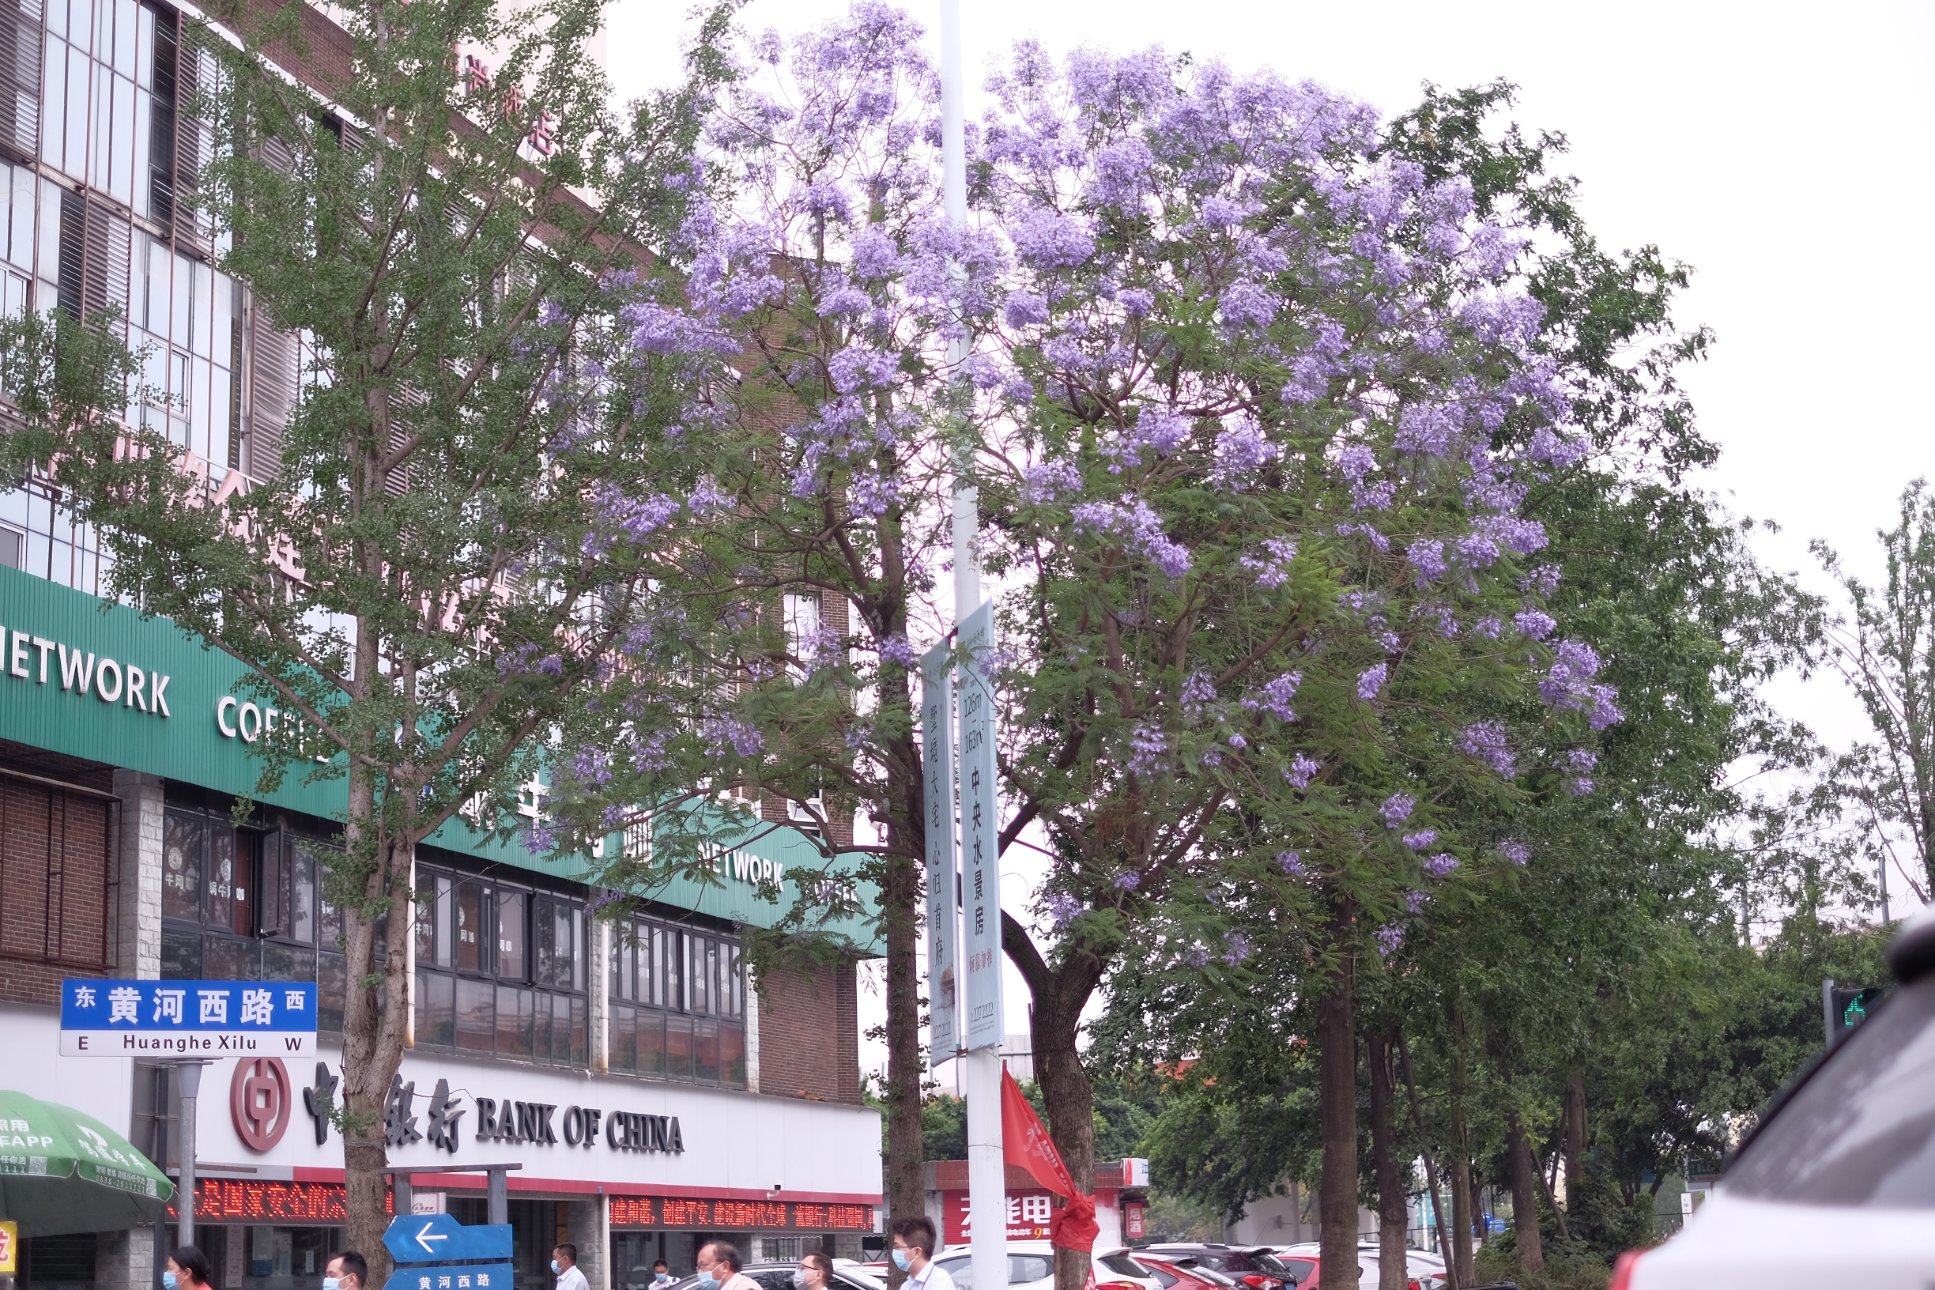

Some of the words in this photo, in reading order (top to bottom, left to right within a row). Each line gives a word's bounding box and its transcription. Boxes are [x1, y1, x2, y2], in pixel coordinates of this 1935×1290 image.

[971, 766, 984, 936] 中央水景房
[75, 986, 96, 1008] 东
[108, 987, 274, 1025] 黄河西路
[285, 990, 306, 1010] 西
[78, 1036, 89, 1050] E
[123, 1034, 212, 1053] Huanghe
[218, 1035, 257, 1050] Xilu
[285, 1037, 302, 1051] W
[303, 1062, 467, 1153] 中银行
[476, 1097, 559, 1144] BANK
[563, 1104, 602, 1149] OF
[606, 1110, 686, 1156] CHINA
[418, 1273, 490, 1290] 黄河西路
